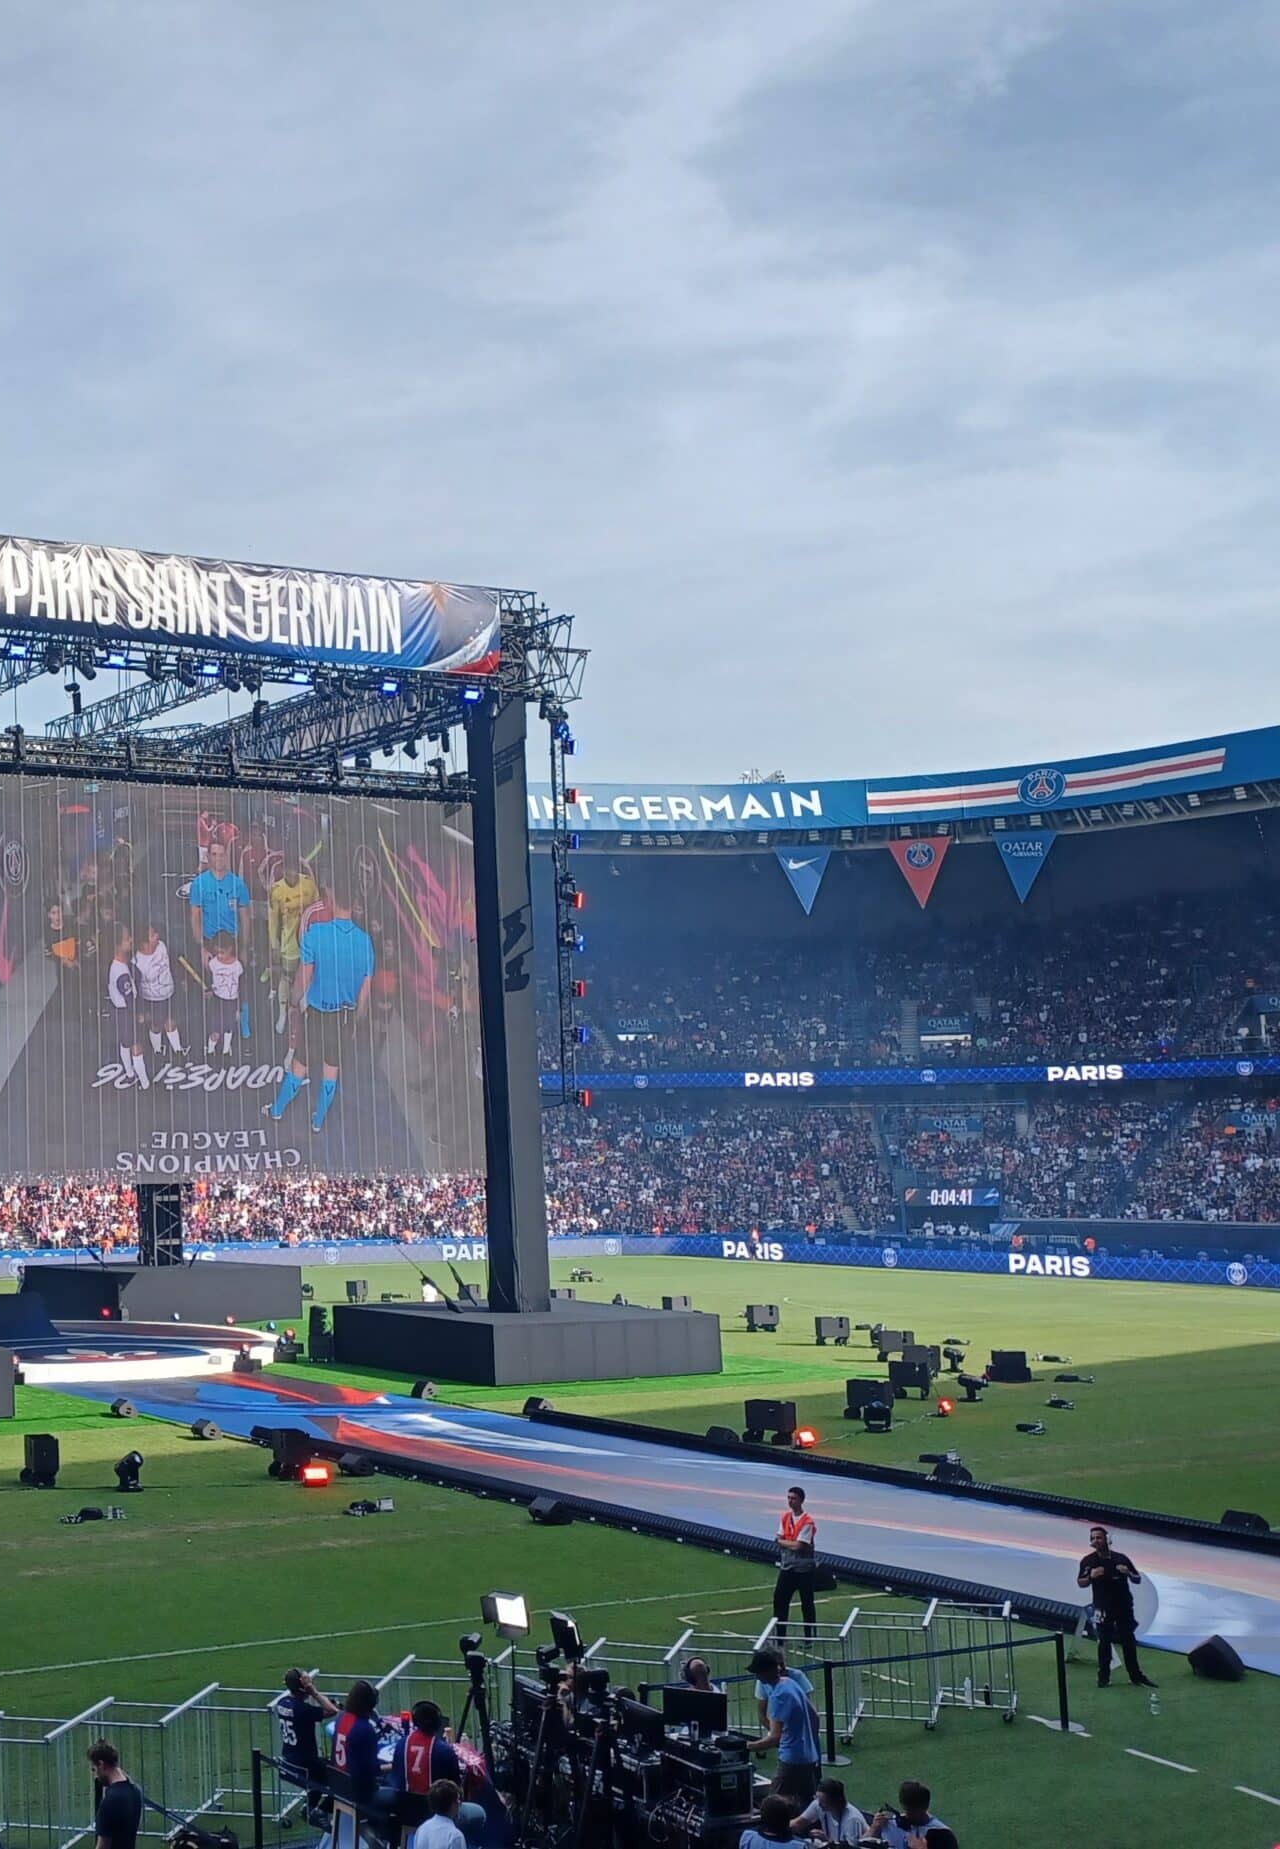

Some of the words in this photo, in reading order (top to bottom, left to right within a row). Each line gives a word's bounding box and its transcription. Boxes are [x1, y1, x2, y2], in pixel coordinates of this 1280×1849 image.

[4, 547, 116, 626] PARIS
[125, 559, 403, 656] SAINT-GERMAIN
[527, 789, 824, 822] INT-GERMAIN
[1001, 842, 1042, 853] QATAR
[744, 1072, 815, 1088] PARIS
[1047, 1064, 1124, 1082] PARIS
[151, 1129, 268, 1150] LEAGUE
[116, 1148, 301, 1174] CHAMPIONS
[442, 1243, 487, 1262] PAR
[1008, 1253, 1091, 1278] PARIS
[410, 1745, 426, 1773] 7
